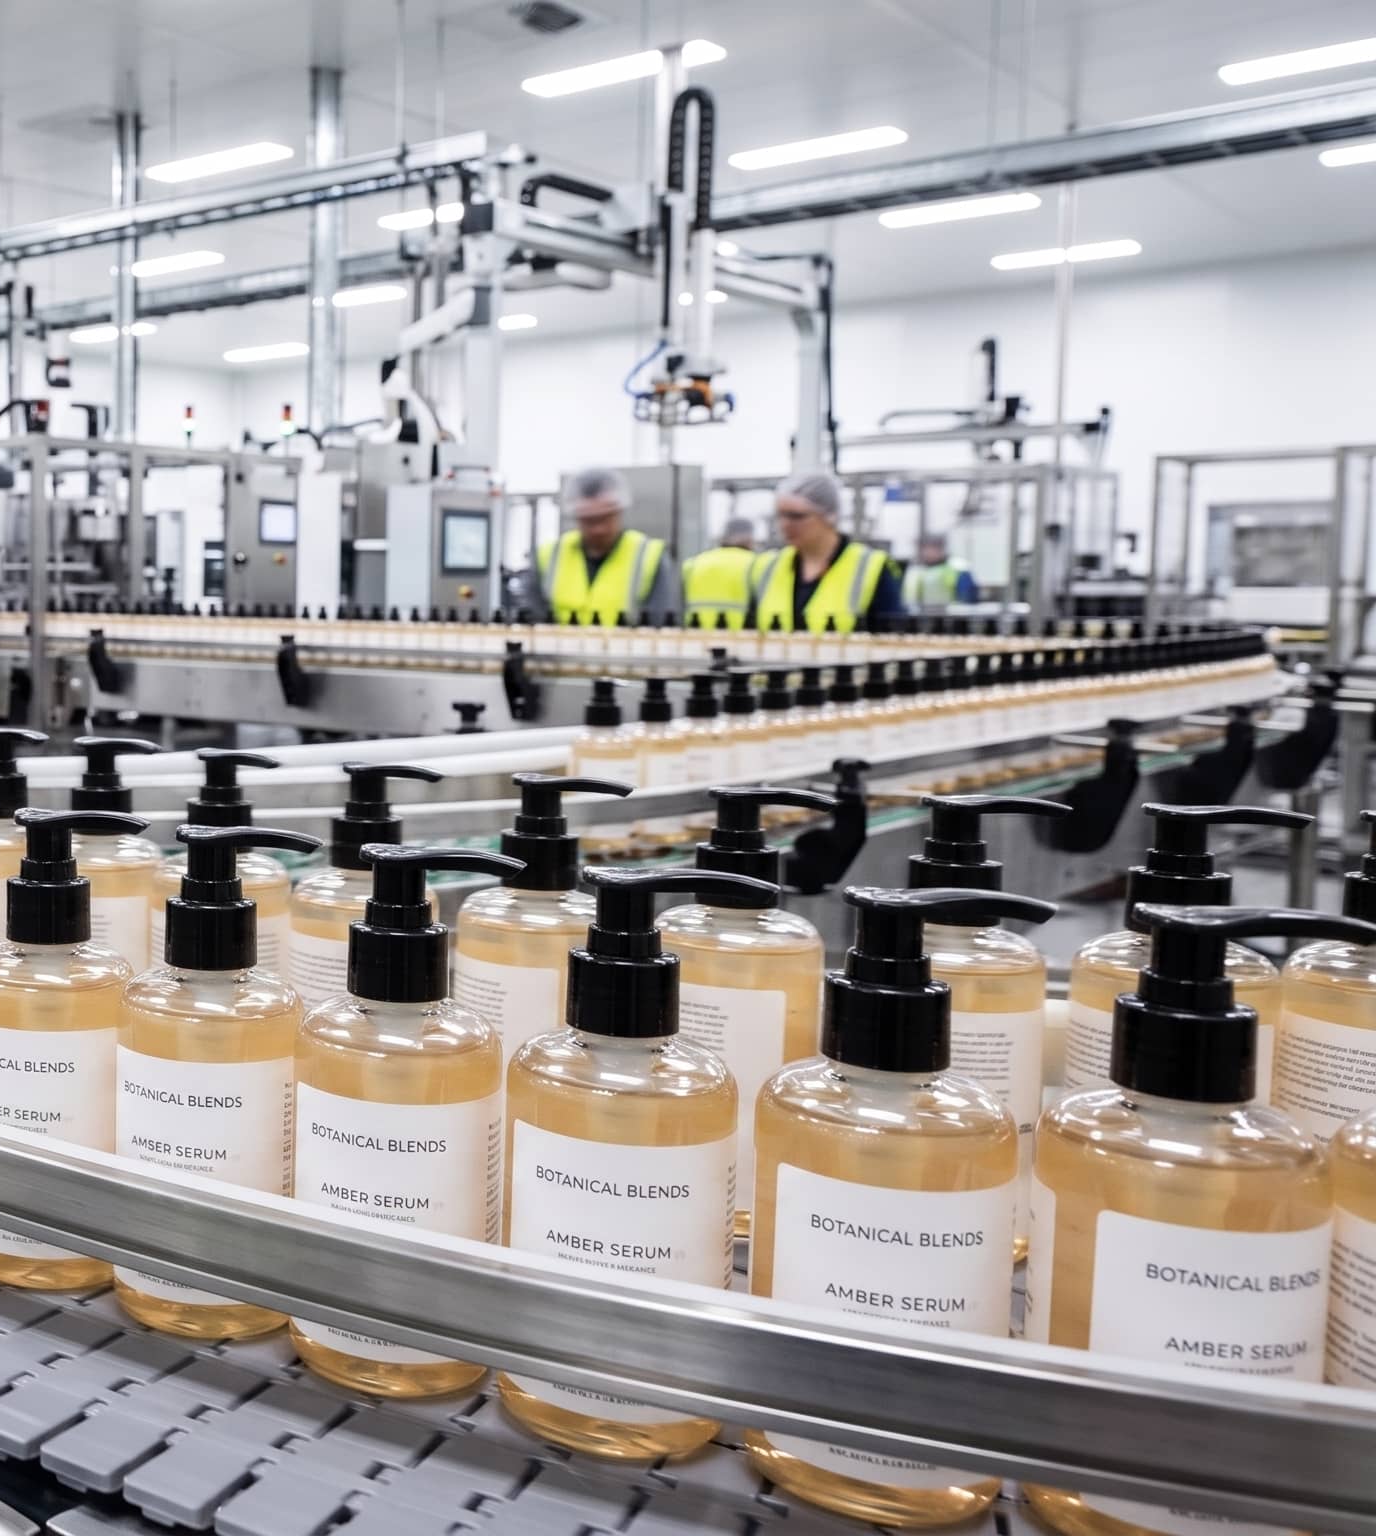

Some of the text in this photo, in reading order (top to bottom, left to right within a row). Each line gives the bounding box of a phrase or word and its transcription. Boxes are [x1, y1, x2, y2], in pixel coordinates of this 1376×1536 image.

[24, 1061, 75, 1073] BLENDS
[124, 1080, 242, 1108] BOTANICAL BLENDS
[14, 1109, 61, 1122] SERUM
[312, 1122, 447, 1153] BOTANICAL BLENDS
[176, 1145, 227, 1160] SERUM
[321, 1182, 429, 1209] AMBER SERUM
[536, 1165, 690, 1199] BOTANICAL BLENDS
[546, 1229, 671, 1260] AMBER SERUM
[811, 1214, 984, 1247] BOTANICAL BLENDS
[1146, 1263, 1321, 1292] BOTANICAL BLENDS
[825, 1283, 965, 1312] AMBER SERUM
[1164, 1337, 1308, 1360] AMBER SERUM
